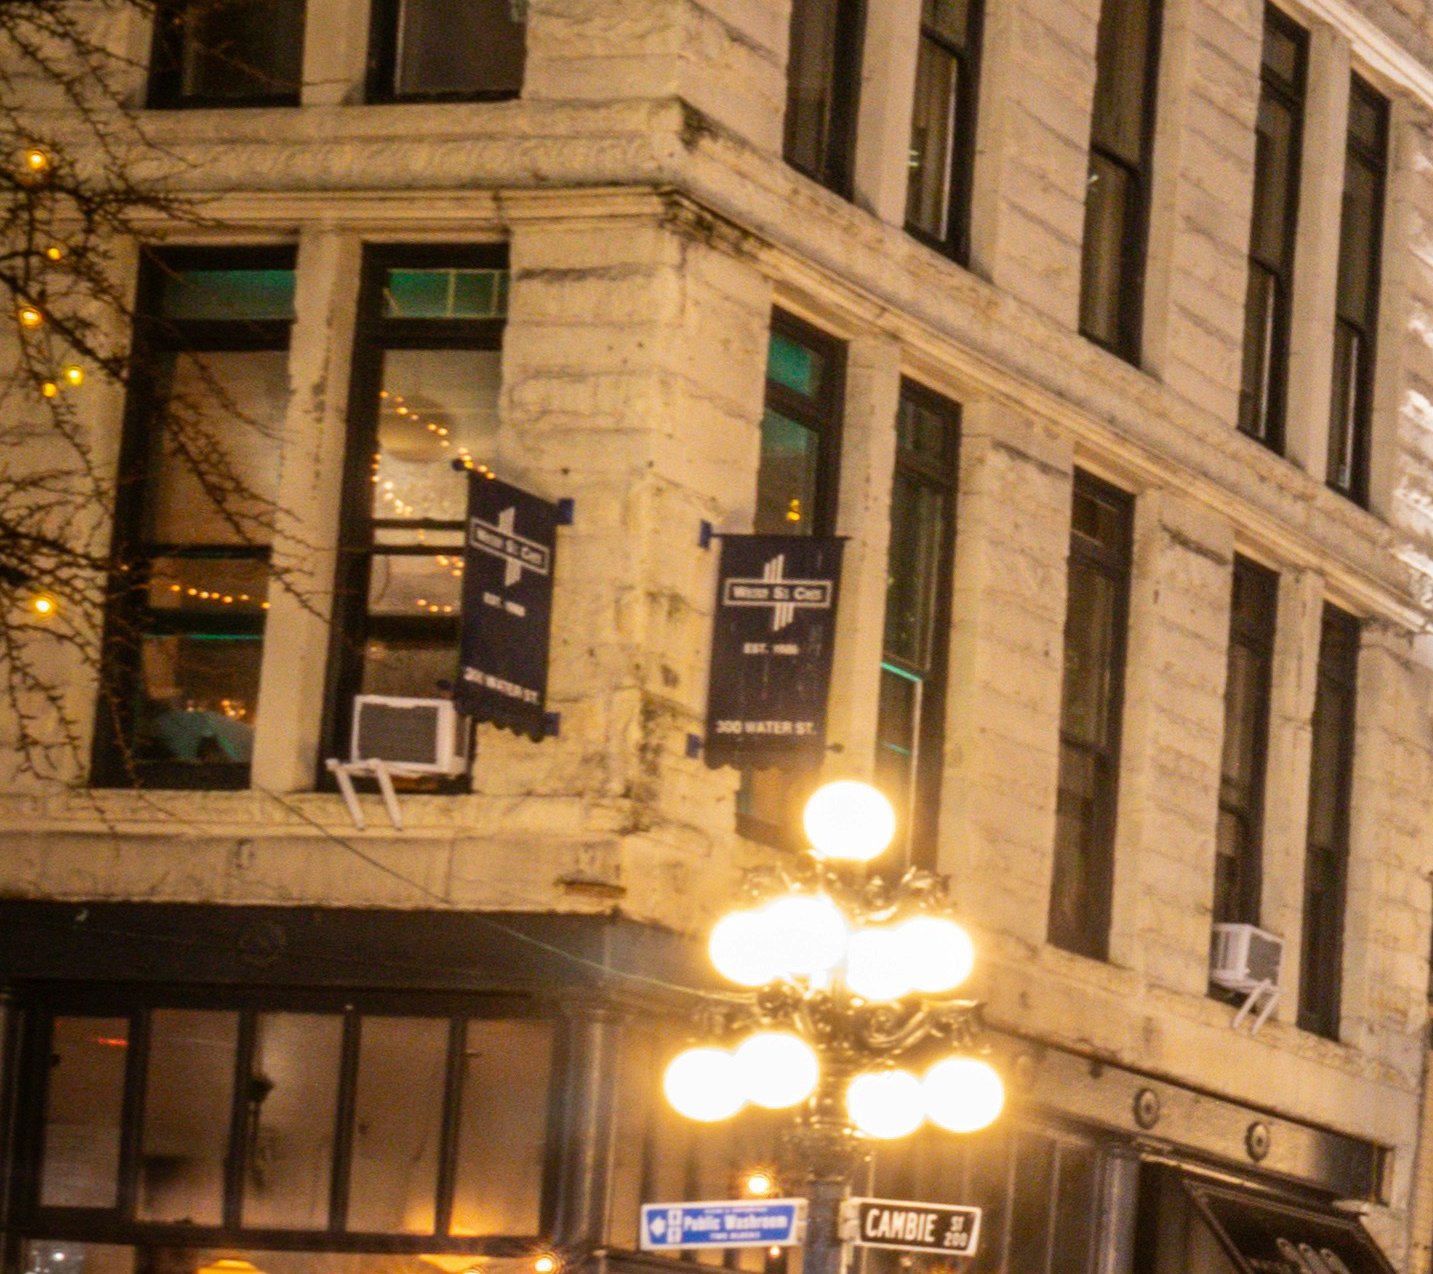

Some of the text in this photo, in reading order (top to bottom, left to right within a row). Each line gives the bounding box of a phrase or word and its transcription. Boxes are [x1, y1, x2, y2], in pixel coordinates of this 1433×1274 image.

[745, 720, 793, 735] WATER
[684, 1213, 788, 1232] Public Washroom
[865, 1208, 936, 1244] CAMBIE
[950, 1217, 965, 1230] ST
[943, 1231, 968, 1248] 200
